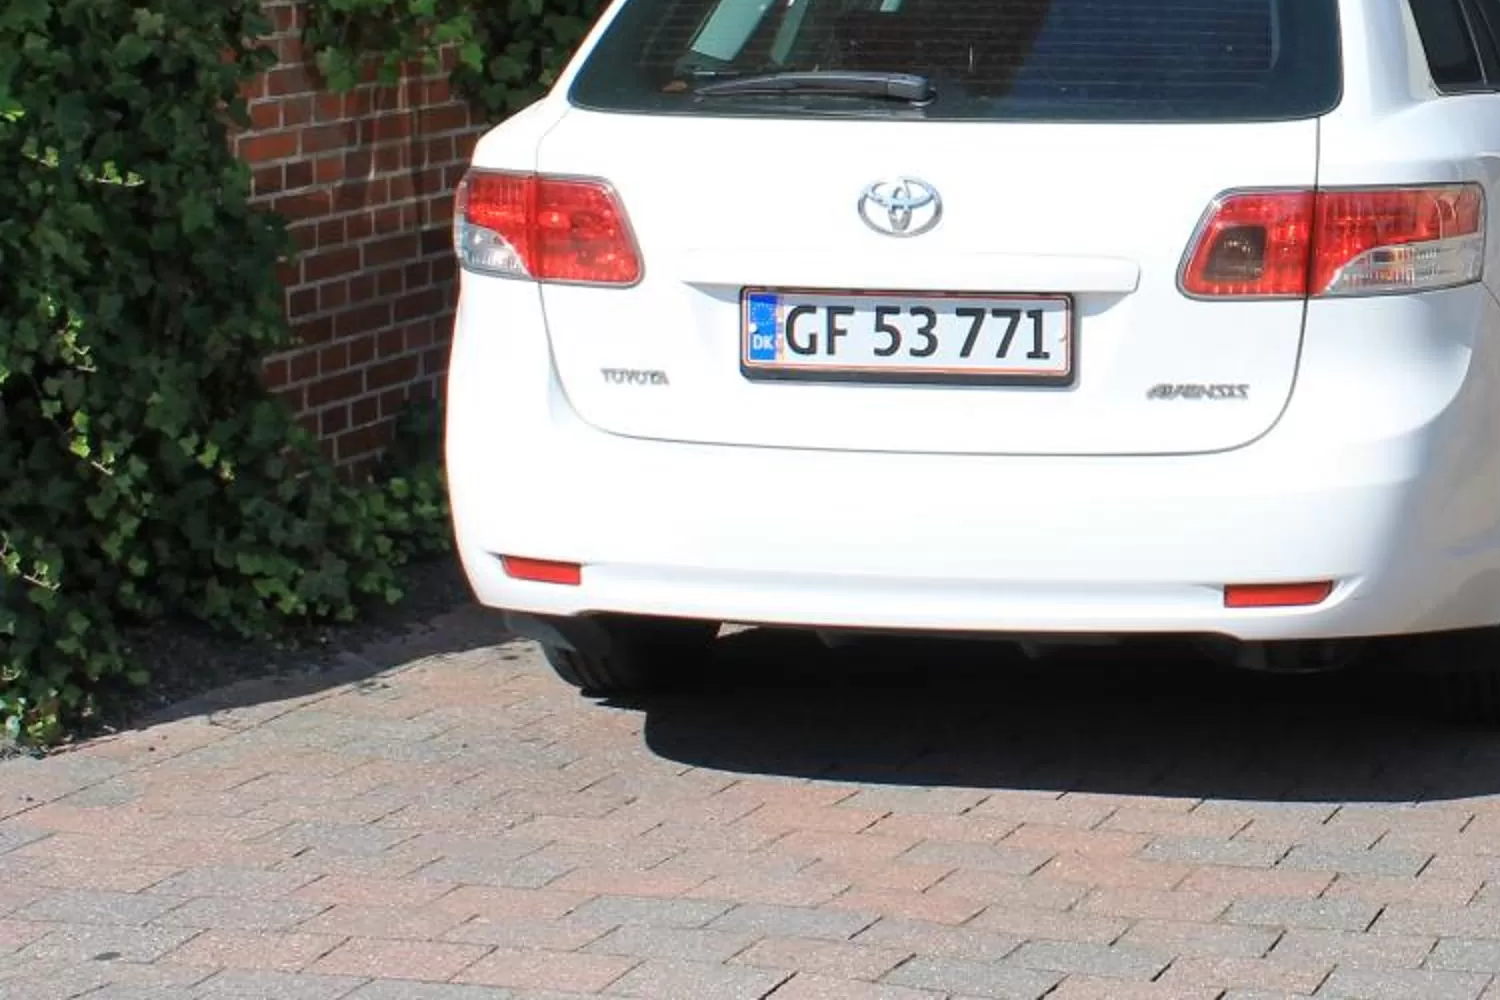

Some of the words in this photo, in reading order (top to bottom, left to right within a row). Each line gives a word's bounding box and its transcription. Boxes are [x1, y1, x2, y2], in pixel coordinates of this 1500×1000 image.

[784, 304, 855, 356] GF
[873, 306, 939, 358] 53
[955, 307, 1050, 360] 771
[752, 336, 775, 350] DK
[599, 367, 671, 386] TOYOTA
